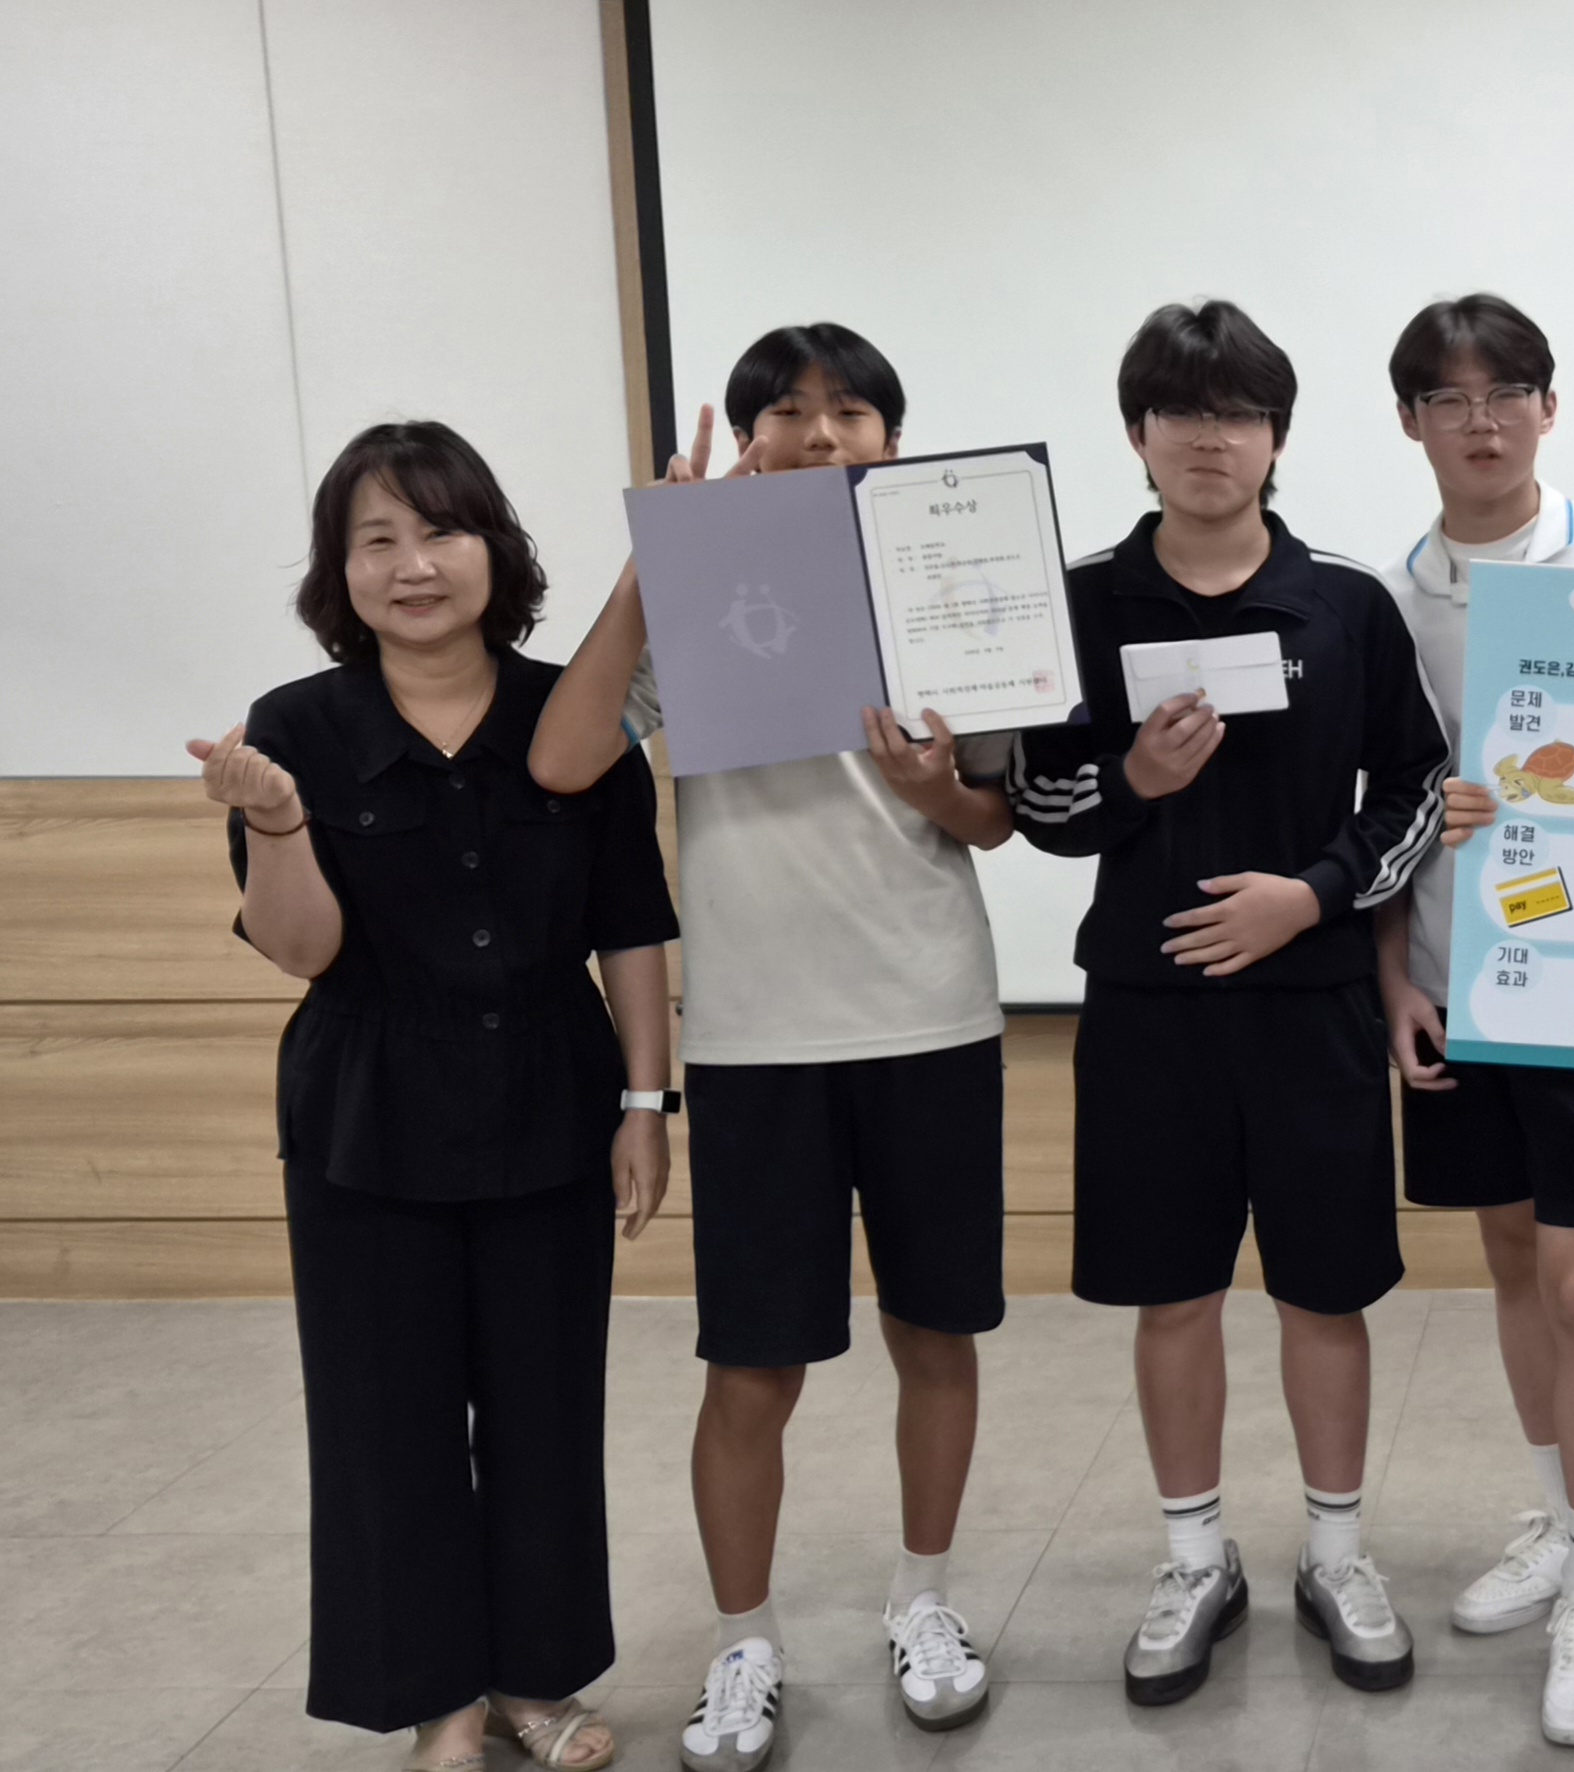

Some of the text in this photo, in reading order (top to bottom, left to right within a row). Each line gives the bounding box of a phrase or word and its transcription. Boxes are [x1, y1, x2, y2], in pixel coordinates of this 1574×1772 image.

[1510, 689, 1543, 709] 문제
[1509, 713, 1541, 732] 발견
[1503, 823, 1536, 843] 해결
[1502, 847, 1536, 867] 방안
[1508, 900, 1527, 915] pay
[1497, 946, 1529, 965] 기대
[1496, 969, 1529, 988] 효과
